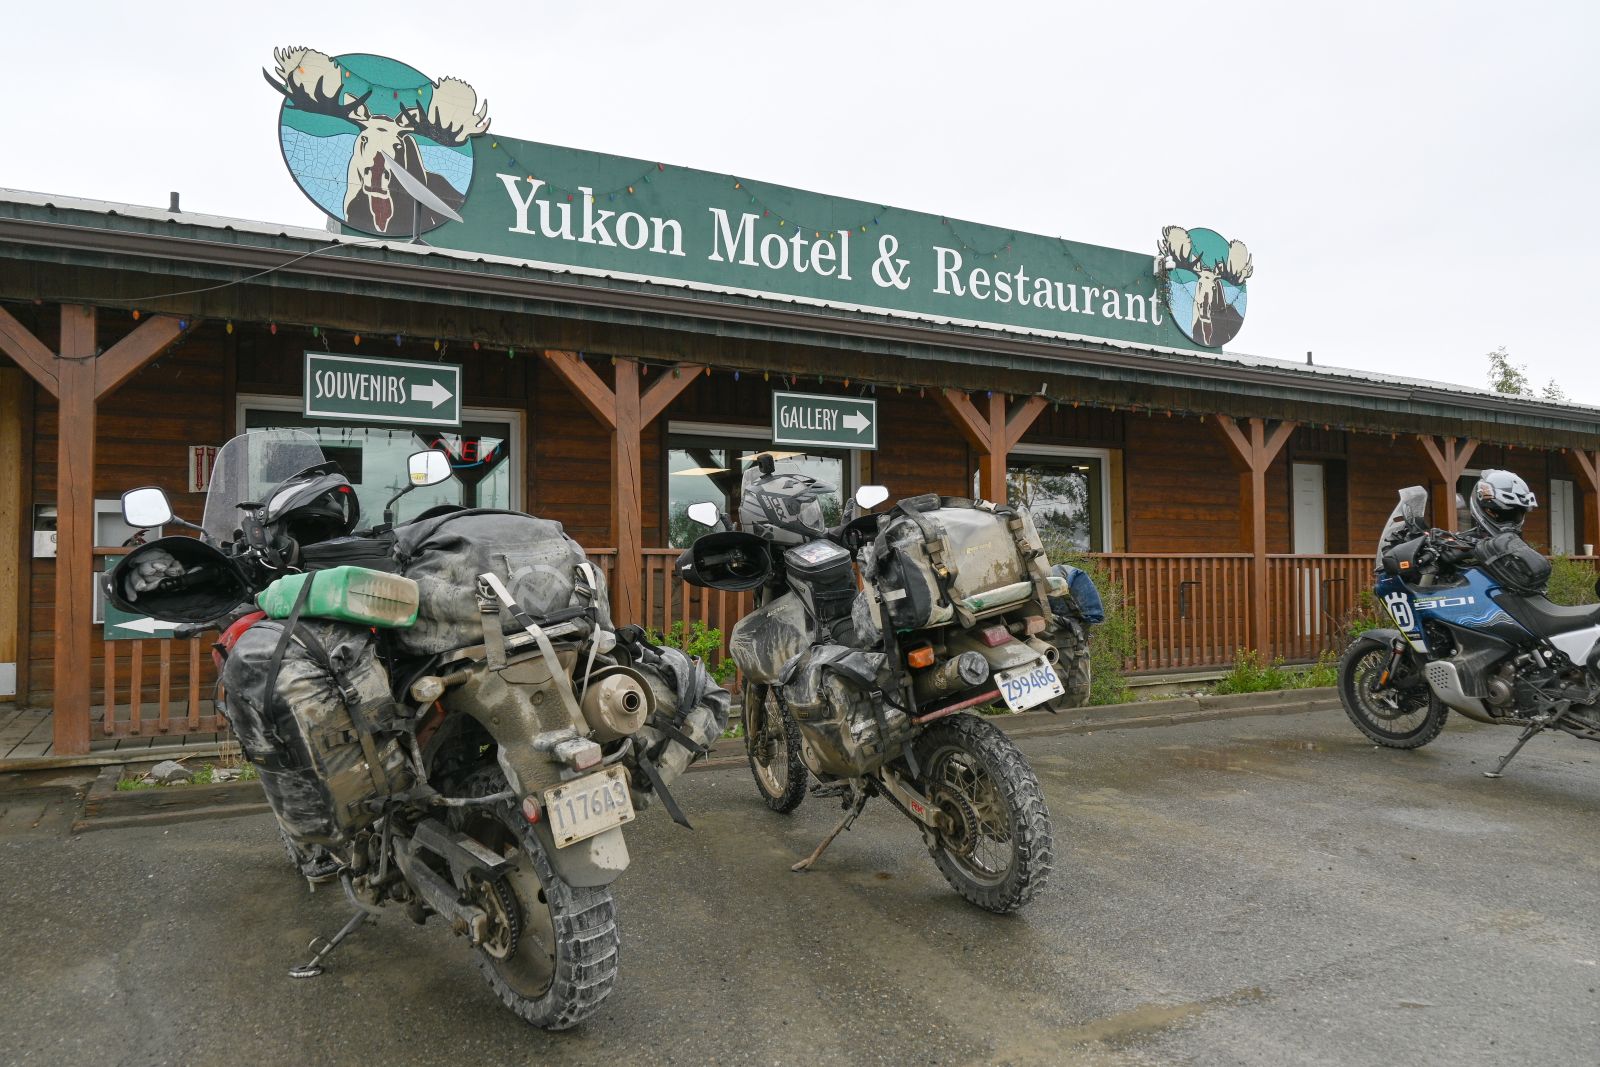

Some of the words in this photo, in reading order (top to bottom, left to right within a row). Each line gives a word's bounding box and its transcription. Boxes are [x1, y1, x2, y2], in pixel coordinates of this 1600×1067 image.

[496, 173, 686, 257] Yukon
[708, 207, 852, 281] Motel
[871, 234, 911, 290] &
[932, 246, 1163, 326] Restaurant
[315, 370, 406, 404] SOUVENIRS
[780, 405, 839, 431] GALLERY
[1413, 596, 1475, 611] 901
[1002, 666, 1056, 702] Z99486
[553, 782, 627, 829] 1176A3
